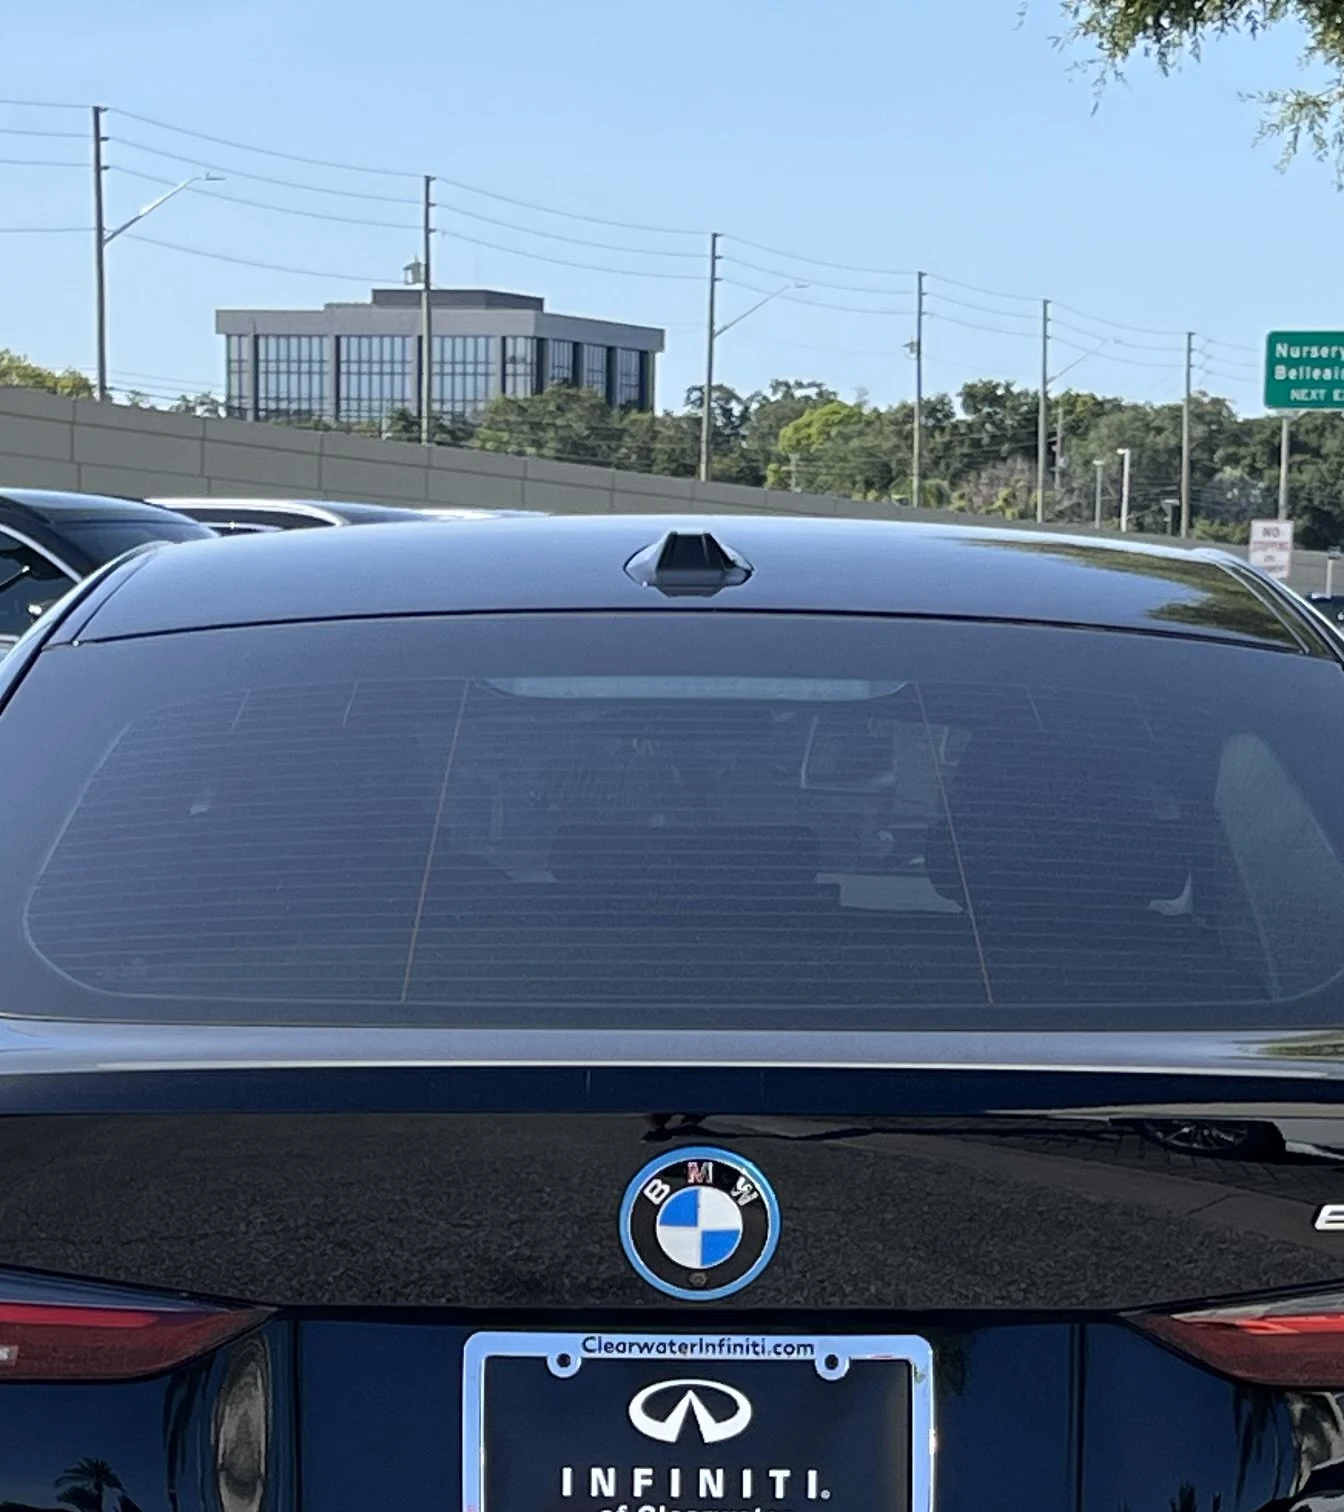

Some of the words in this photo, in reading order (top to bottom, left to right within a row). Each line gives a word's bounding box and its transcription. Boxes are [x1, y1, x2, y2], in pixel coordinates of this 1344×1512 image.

[1289, 388, 1327, 401] NEXT
[1262, 526, 1280, 538] NO
[643, 1161, 759, 1206] BMW
[581, 1335, 816, 1357] ClearwaterInfiniti.com
[562, 1467, 819, 1499] INFINITI
